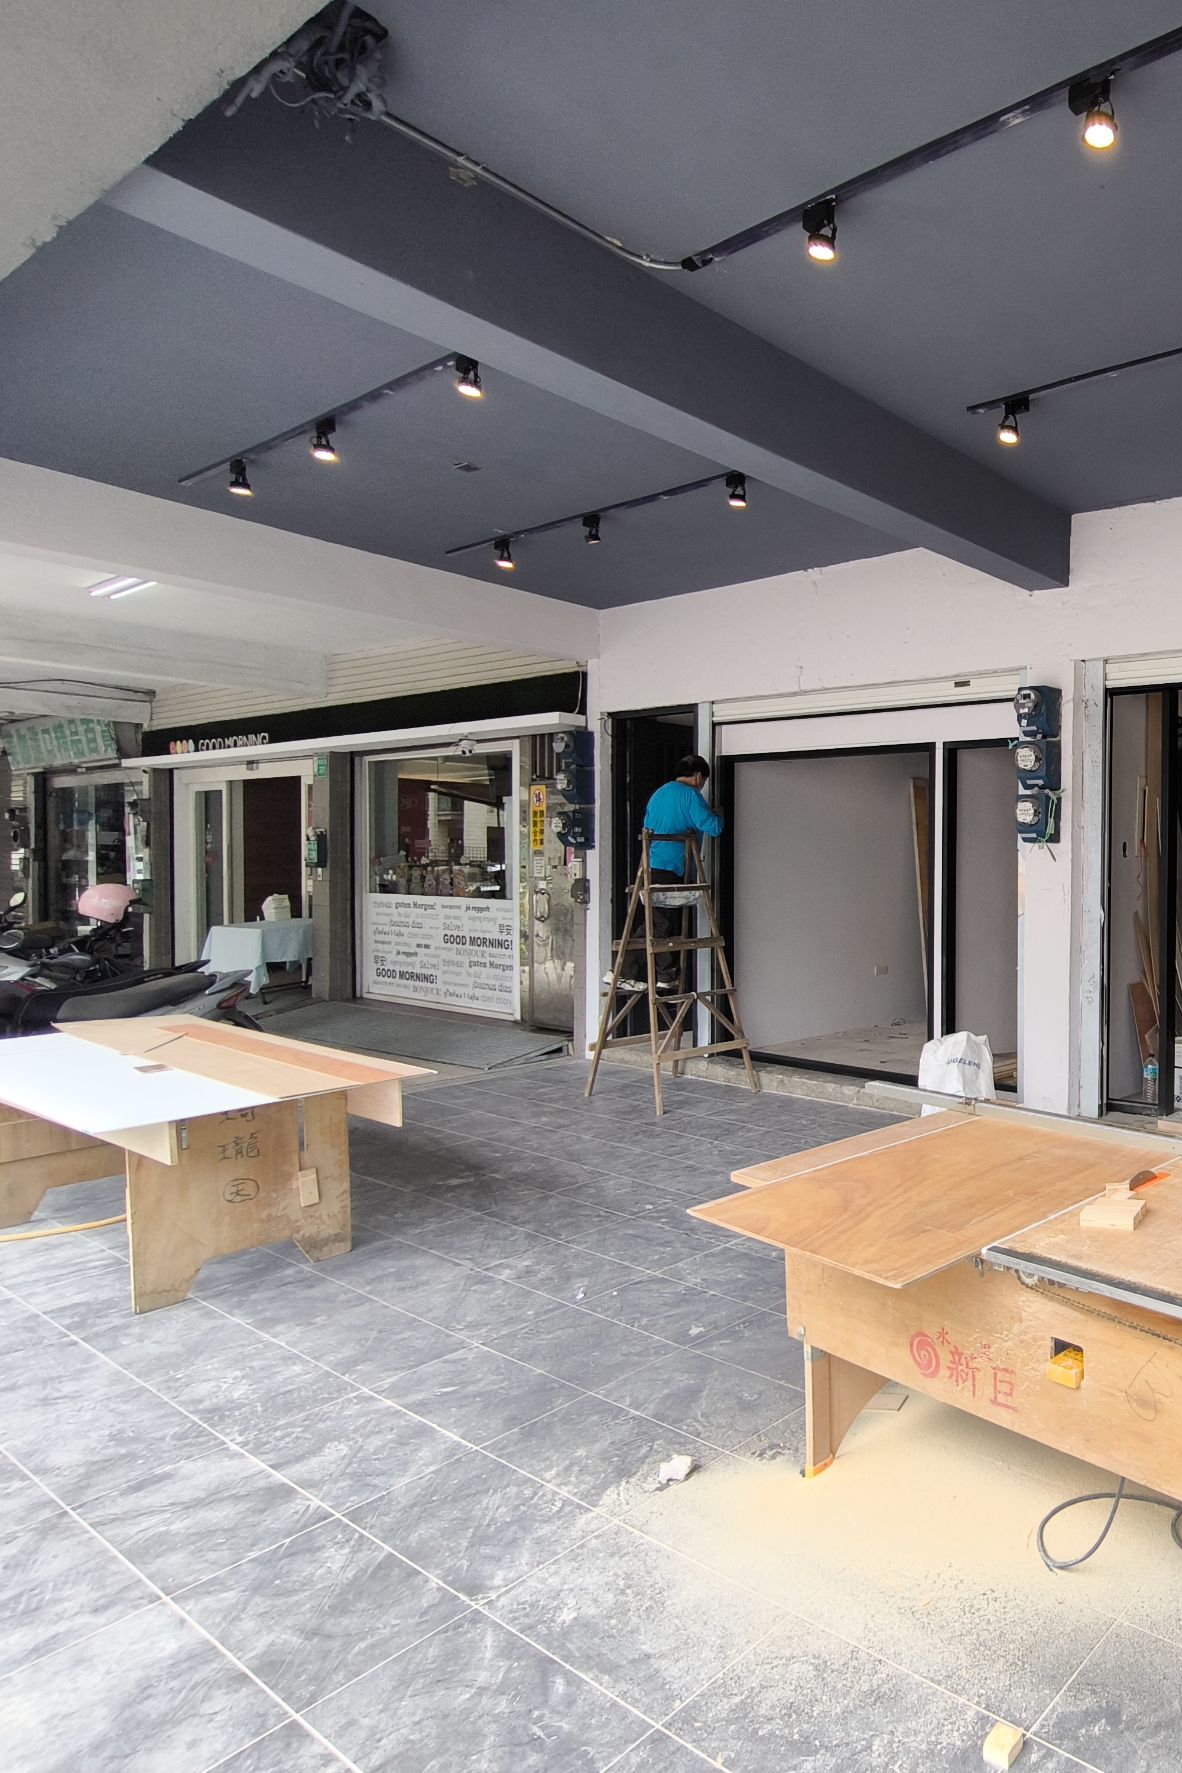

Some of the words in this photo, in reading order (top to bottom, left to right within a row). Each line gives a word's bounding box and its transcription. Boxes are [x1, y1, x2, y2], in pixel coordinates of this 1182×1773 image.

[198, 737, 223, 752] GOOD
[224, 732, 269, 749] MORNING!
[443, 933, 467, 946] GOOD
[469, 935, 513, 950] MORNING!
[468, 960, 488, 969] guten
[375, 968, 397, 979] GOOD
[398, 969, 438, 985] MORNING!
